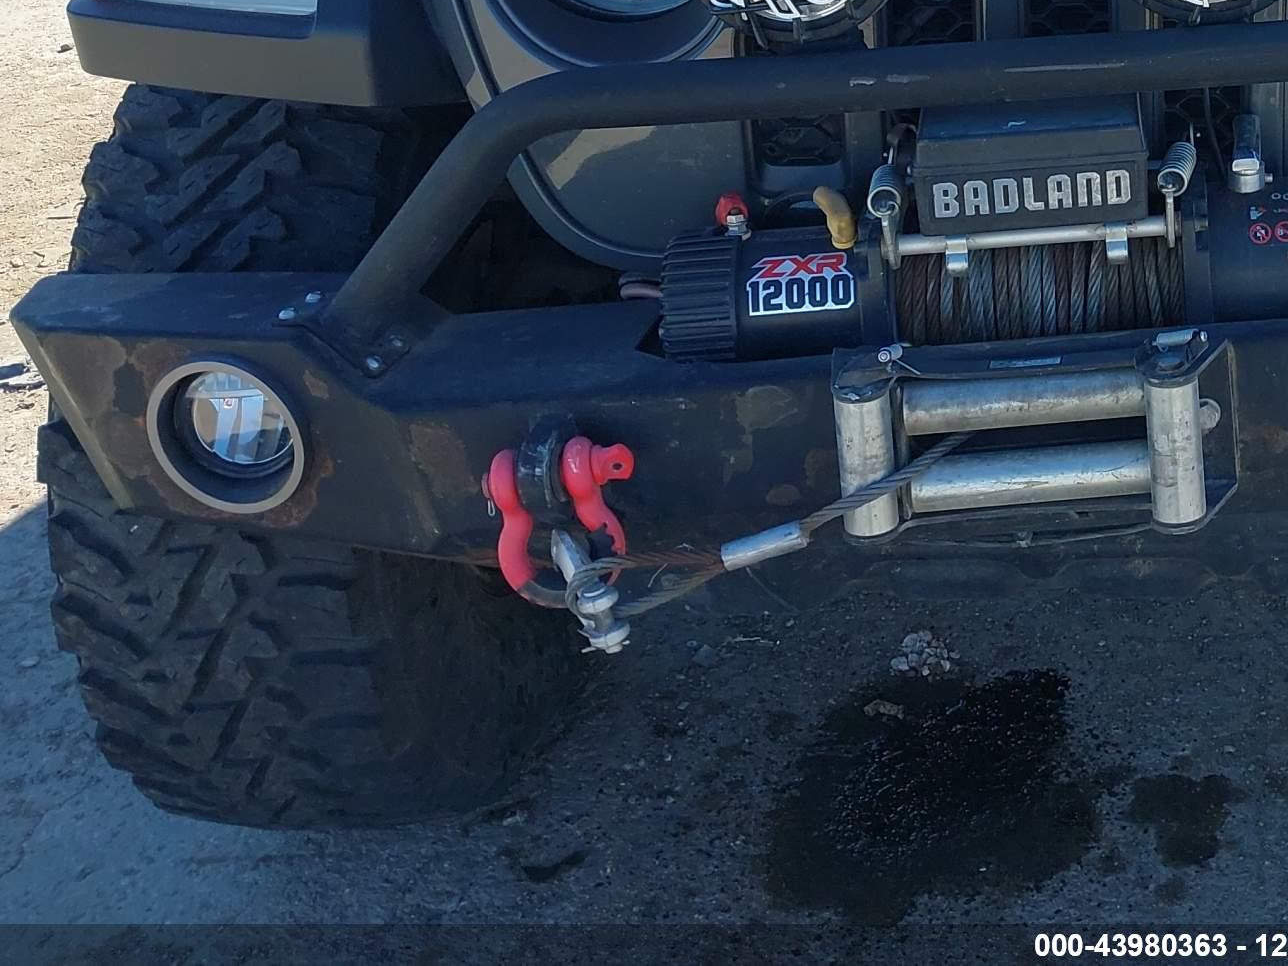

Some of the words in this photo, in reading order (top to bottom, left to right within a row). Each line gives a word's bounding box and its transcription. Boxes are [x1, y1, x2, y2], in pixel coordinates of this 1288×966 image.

[932, 169, 1132, 218] BADLAND
[754, 253, 847, 280] ZXR
[747, 274, 855, 315] 12000
